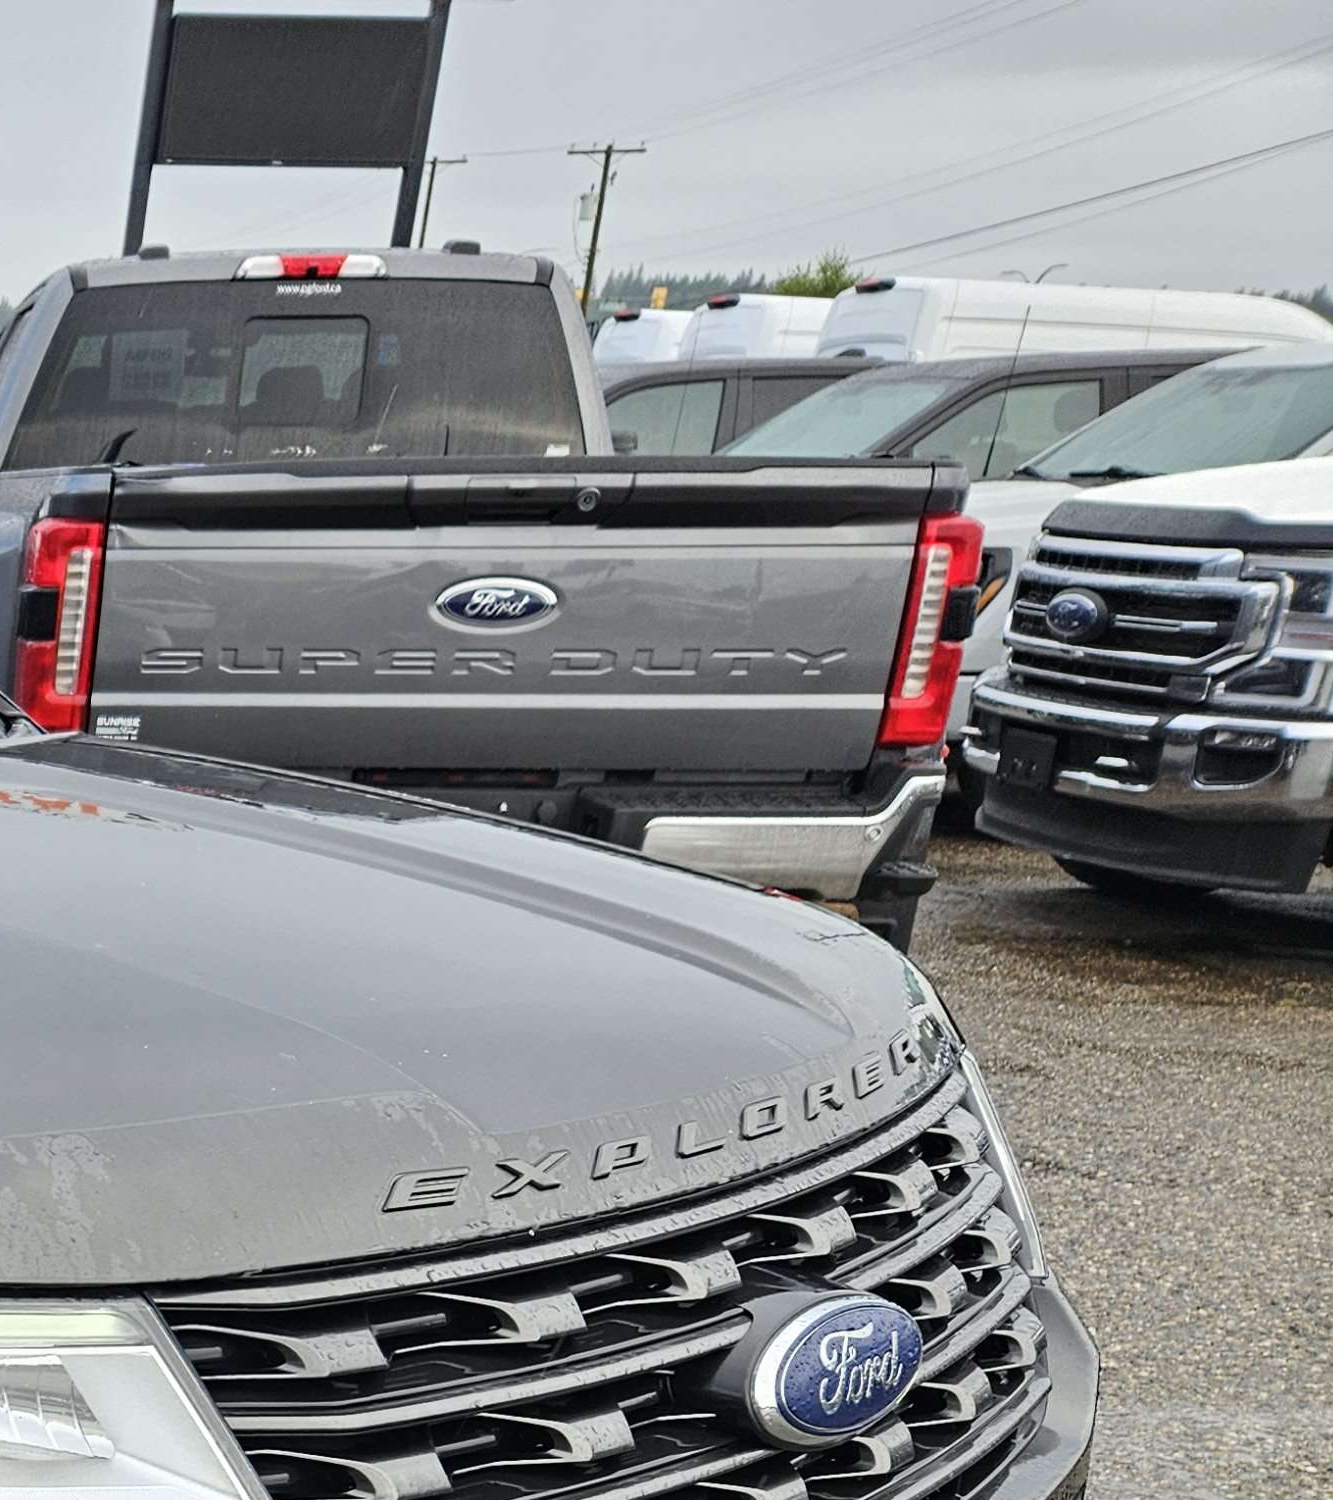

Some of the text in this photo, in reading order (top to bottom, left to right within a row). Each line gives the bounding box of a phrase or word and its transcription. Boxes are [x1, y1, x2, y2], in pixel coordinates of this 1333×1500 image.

[465, 588, 531, 617] Ford
[140, 647, 848, 676] SUPER DUTY
[381, 1028, 920, 1213] EXPLORER
[819, 1321, 904, 1415] Ford
